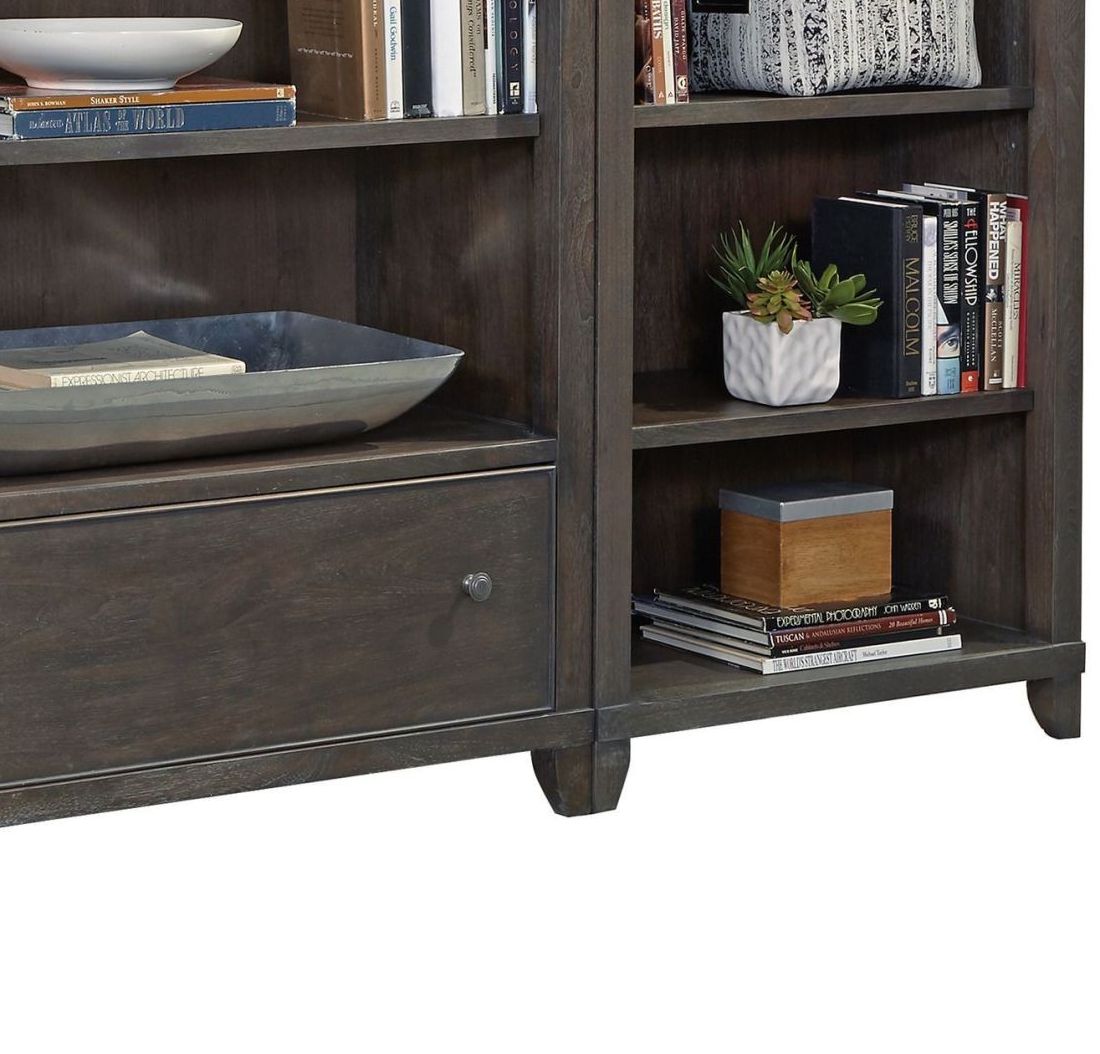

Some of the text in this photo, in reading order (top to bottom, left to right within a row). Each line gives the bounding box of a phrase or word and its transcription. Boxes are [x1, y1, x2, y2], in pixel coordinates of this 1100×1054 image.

[652, 1, 661, 39] BATHS
[90, 96, 117, 105] SHAKER
[65, 111, 111, 133] ATLAS
[134, 108, 186, 129] WORLD
[989, 202, 999, 280] HAPPENED
[906, 258, 920, 355] MALCOLM
[826, 607, 877, 621] PHOTOGRAPHY
[776, 632, 804, 643] TUSCAN
